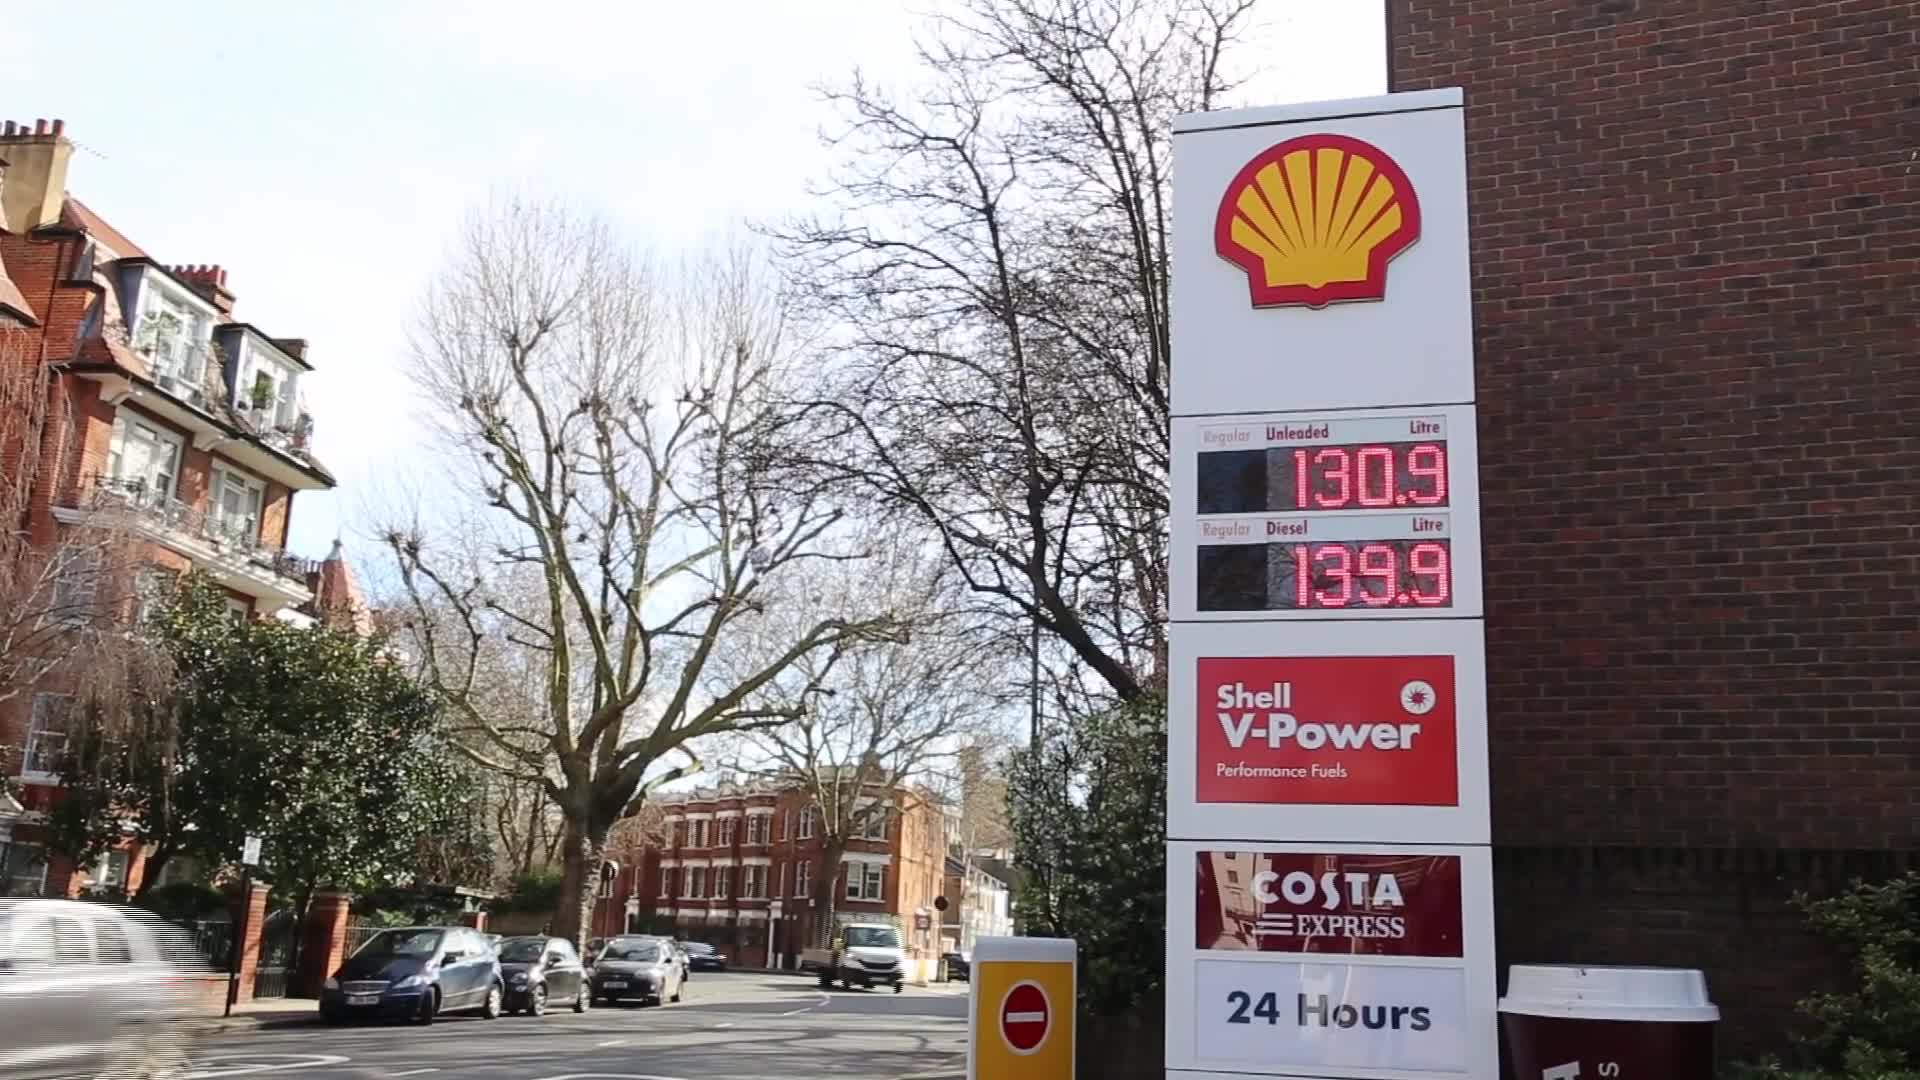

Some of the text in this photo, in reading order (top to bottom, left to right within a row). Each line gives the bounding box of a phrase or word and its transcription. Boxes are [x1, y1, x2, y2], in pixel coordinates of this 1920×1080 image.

[1265, 423, 1329, 441] Unleaded
[1409, 419, 1441, 435] Litre
[1293, 444, 1447, 508] 130.9
[1202, 517, 1443, 539] Regular Diesel Litre
[1294, 543, 1449, 607] 139.9
[1216, 681, 1291, 710] Shell
[1216, 712, 1422, 750] V-Power
[1216, 761, 1349, 779] Performance Fuels
[1253, 870, 1405, 911] COSTA
[1296, 914, 1406, 939] EXPRESS
[1226, 990, 1432, 1032] 24 Hours
